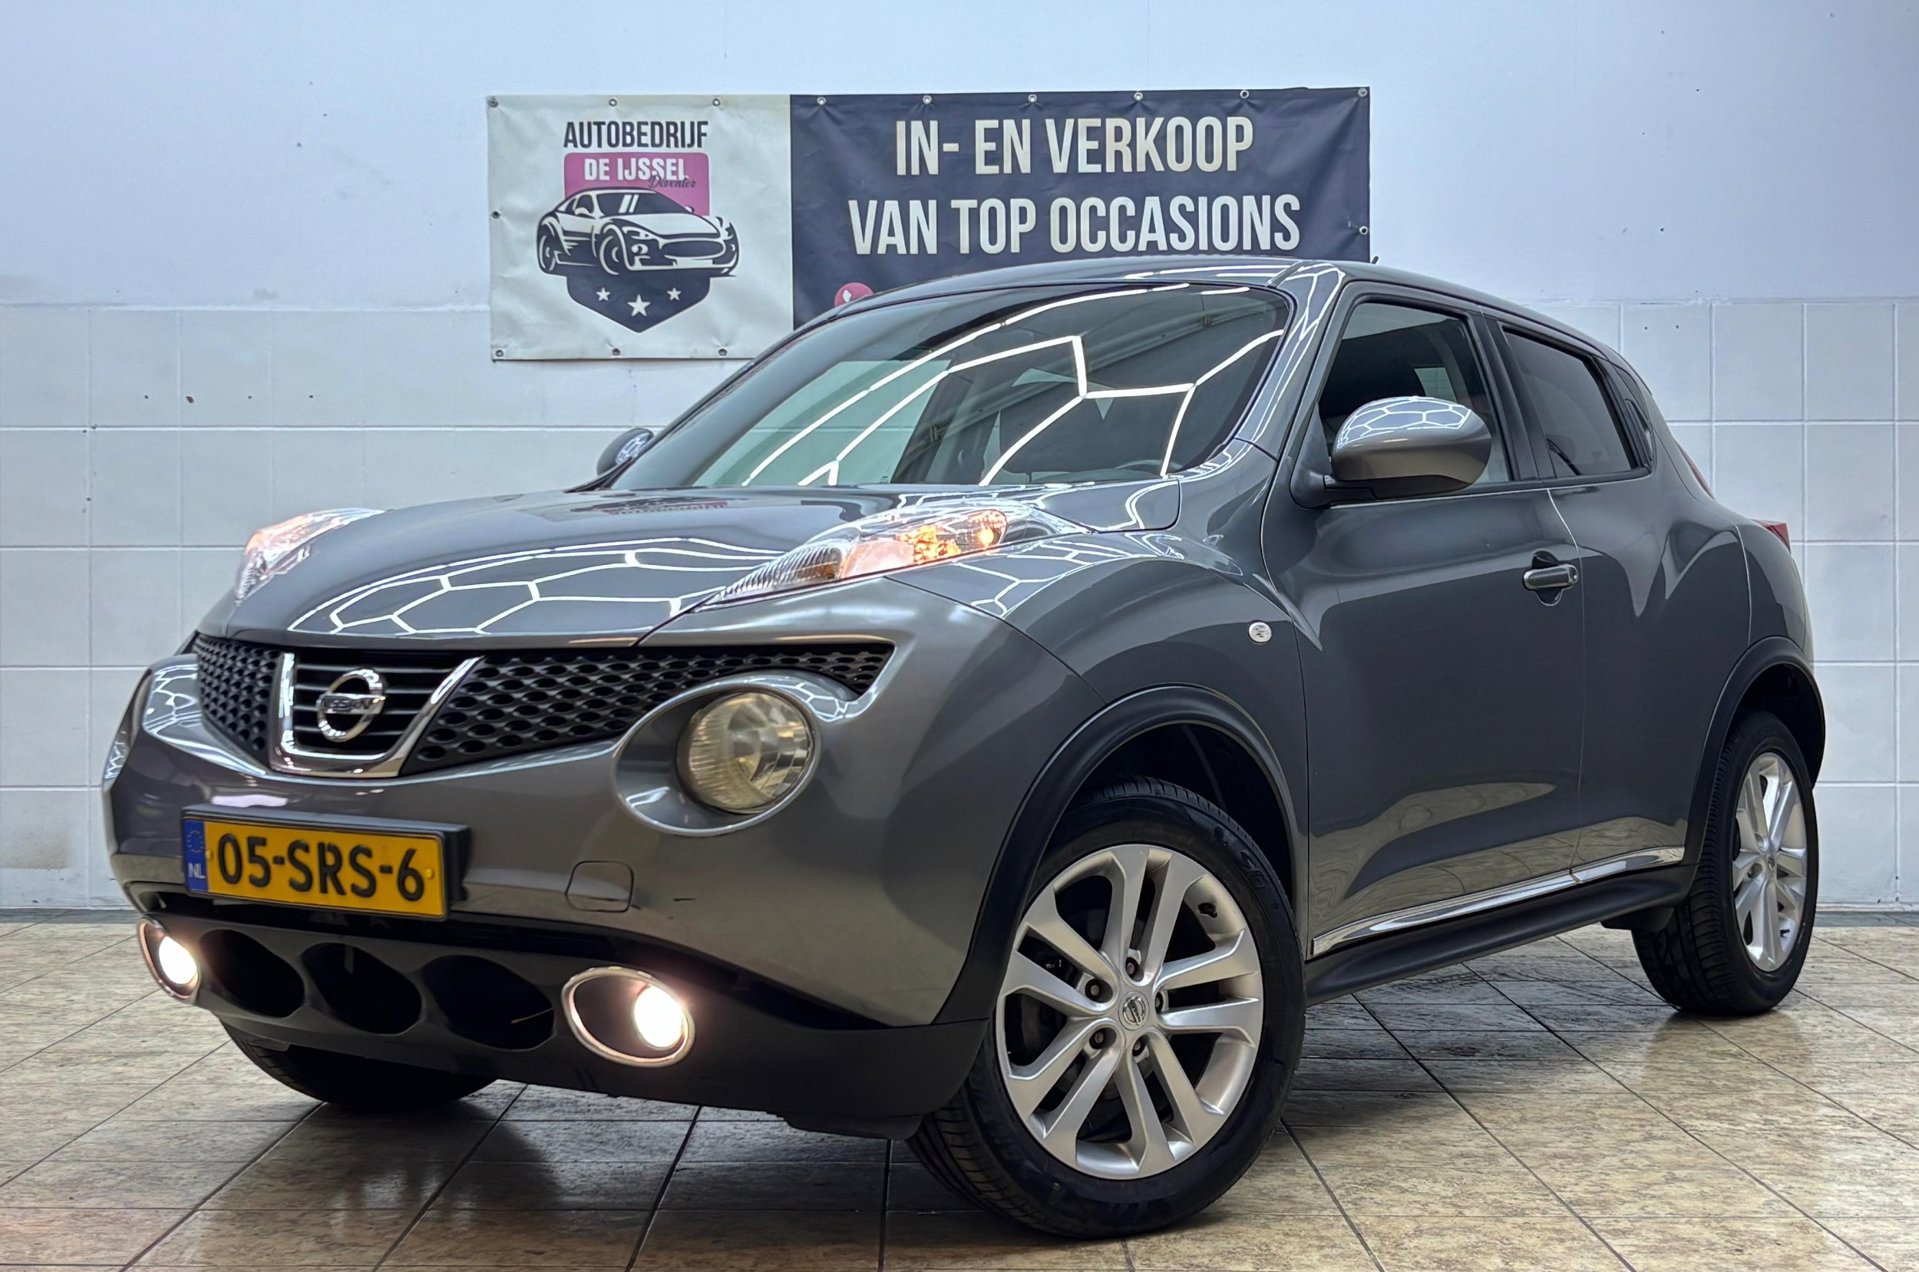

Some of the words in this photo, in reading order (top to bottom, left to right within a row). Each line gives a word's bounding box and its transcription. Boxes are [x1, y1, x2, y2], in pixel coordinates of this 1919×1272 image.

[563, 120, 708, 148] AUTOBEDRIJF
[896, 119, 960, 176] IN-
[974, 119, 1031, 174] EN
[1044, 116, 1254, 174] VERKOOP
[584, 158, 610, 181] DE
[617, 157, 688, 182] IJSSEL
[848, 199, 937, 255] VAN
[950, 199, 1036, 254] TOP
[1049, 194, 1301, 253] OCCASIONS
[188, 863, 206, 879] NL
[217, 832, 425, 902] 05-SRS-6
